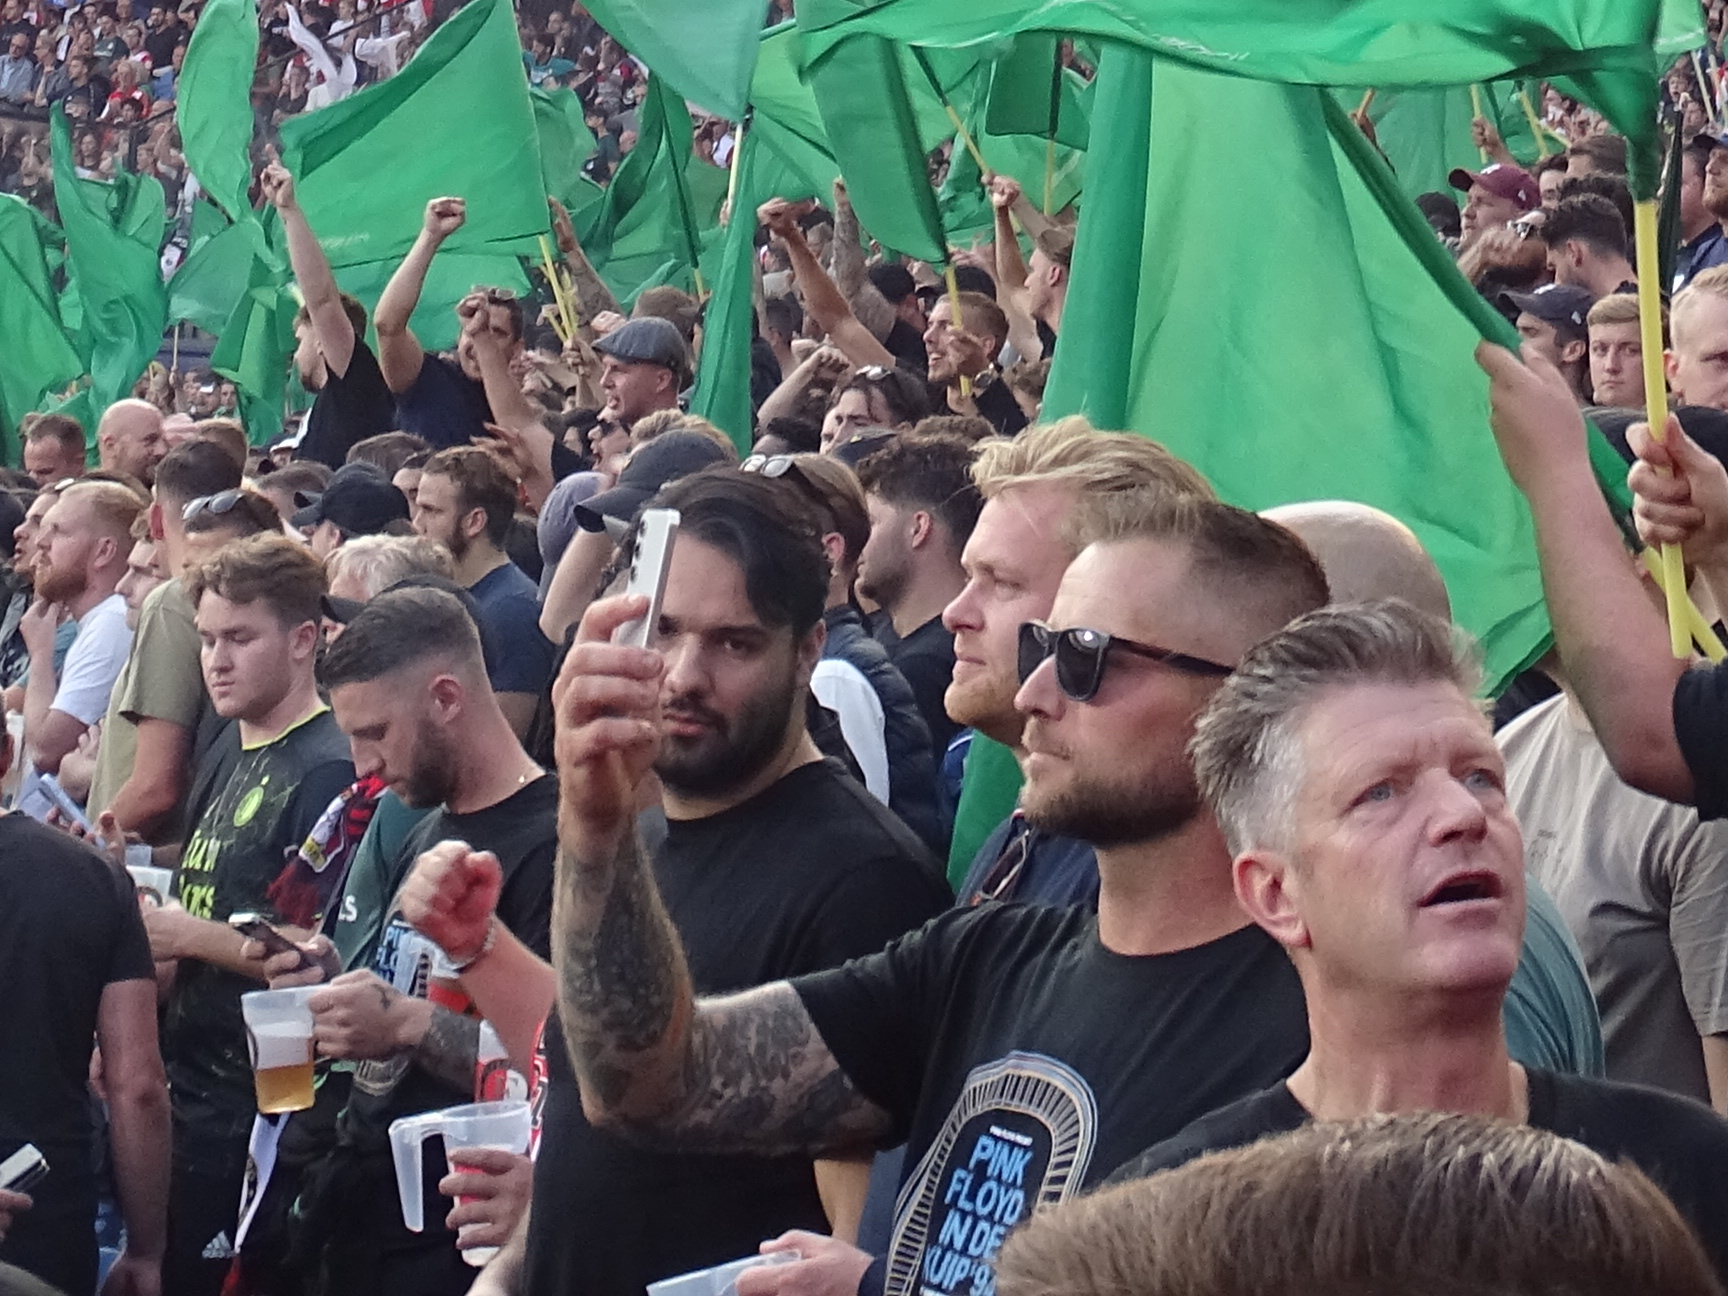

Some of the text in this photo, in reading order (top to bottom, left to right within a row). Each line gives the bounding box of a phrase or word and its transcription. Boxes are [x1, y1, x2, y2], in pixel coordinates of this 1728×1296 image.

[969, 1134, 1034, 1188] PINK
[944, 1167, 1025, 1226] FLOYD
[938, 1208, 1007, 1260] IN DE
